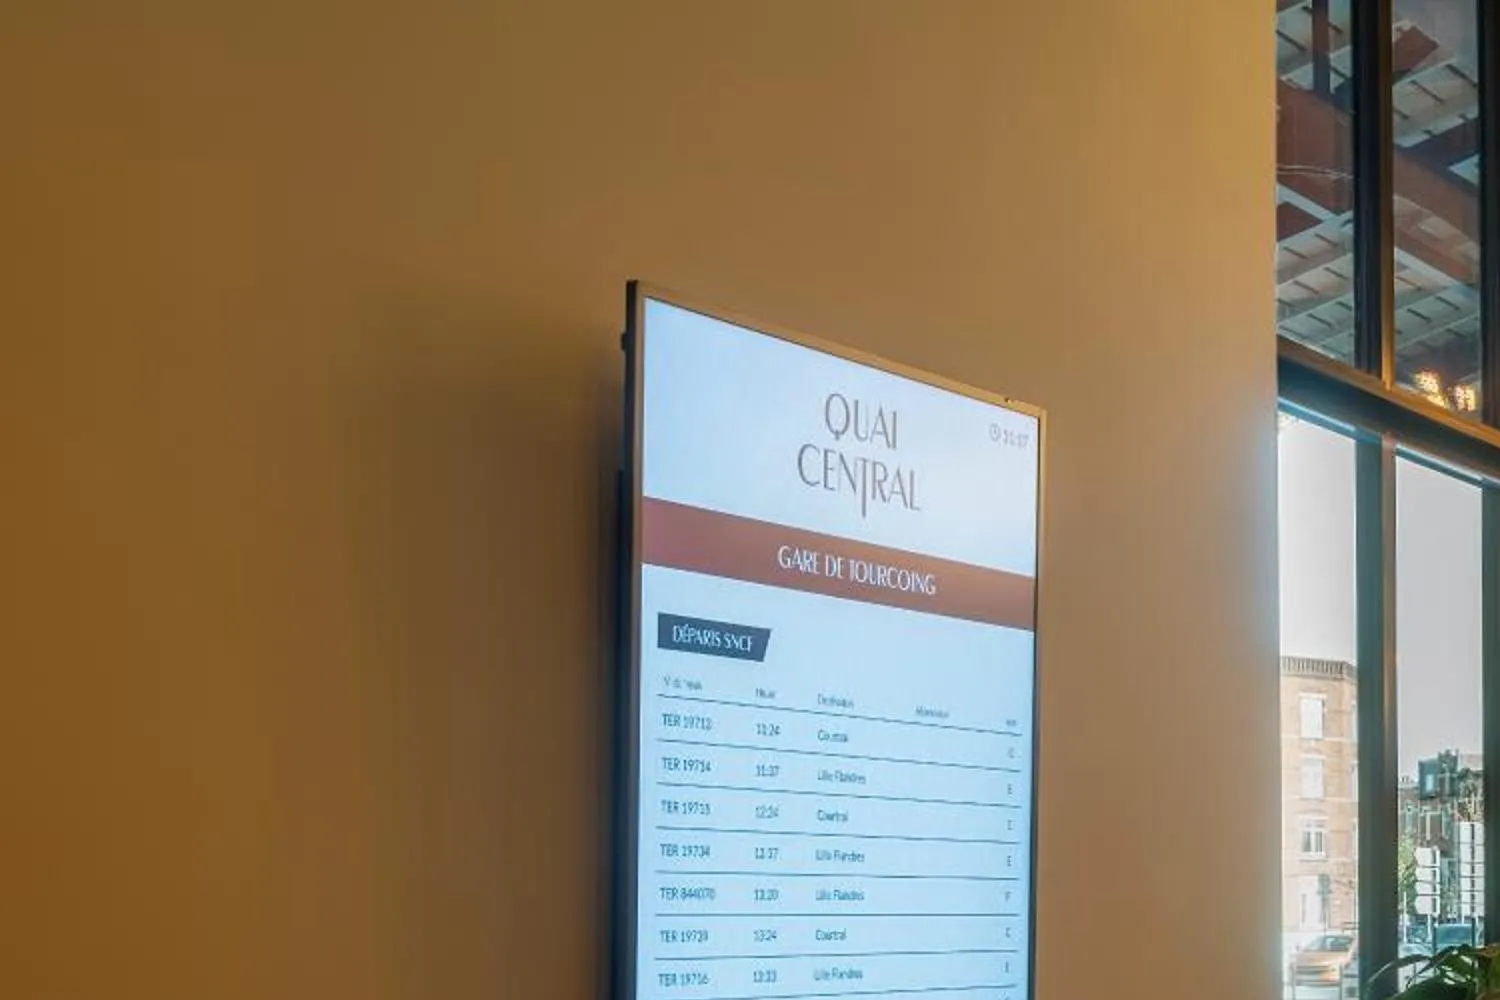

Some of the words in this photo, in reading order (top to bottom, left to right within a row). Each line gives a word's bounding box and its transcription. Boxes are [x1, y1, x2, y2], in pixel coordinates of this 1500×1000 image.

[824, 393, 898, 449] QUAI
[797, 443, 921, 518] CENTRAL
[777, 545, 819, 574] GARE
[824, 555, 845, 579] DE
[848, 557, 936, 595] TOURCOING
[672, 623, 721, 648] DÉPARTS
[725, 632, 753, 653] SNCF
[662, 713, 681, 728] TER
[662, 757, 681, 772] TER
[661, 800, 679, 814] TER
[660, 843, 679, 857] TER
[660, 887, 678, 900] TER
[660, 930, 679, 943] TER
[658, 973, 677, 987] TER
